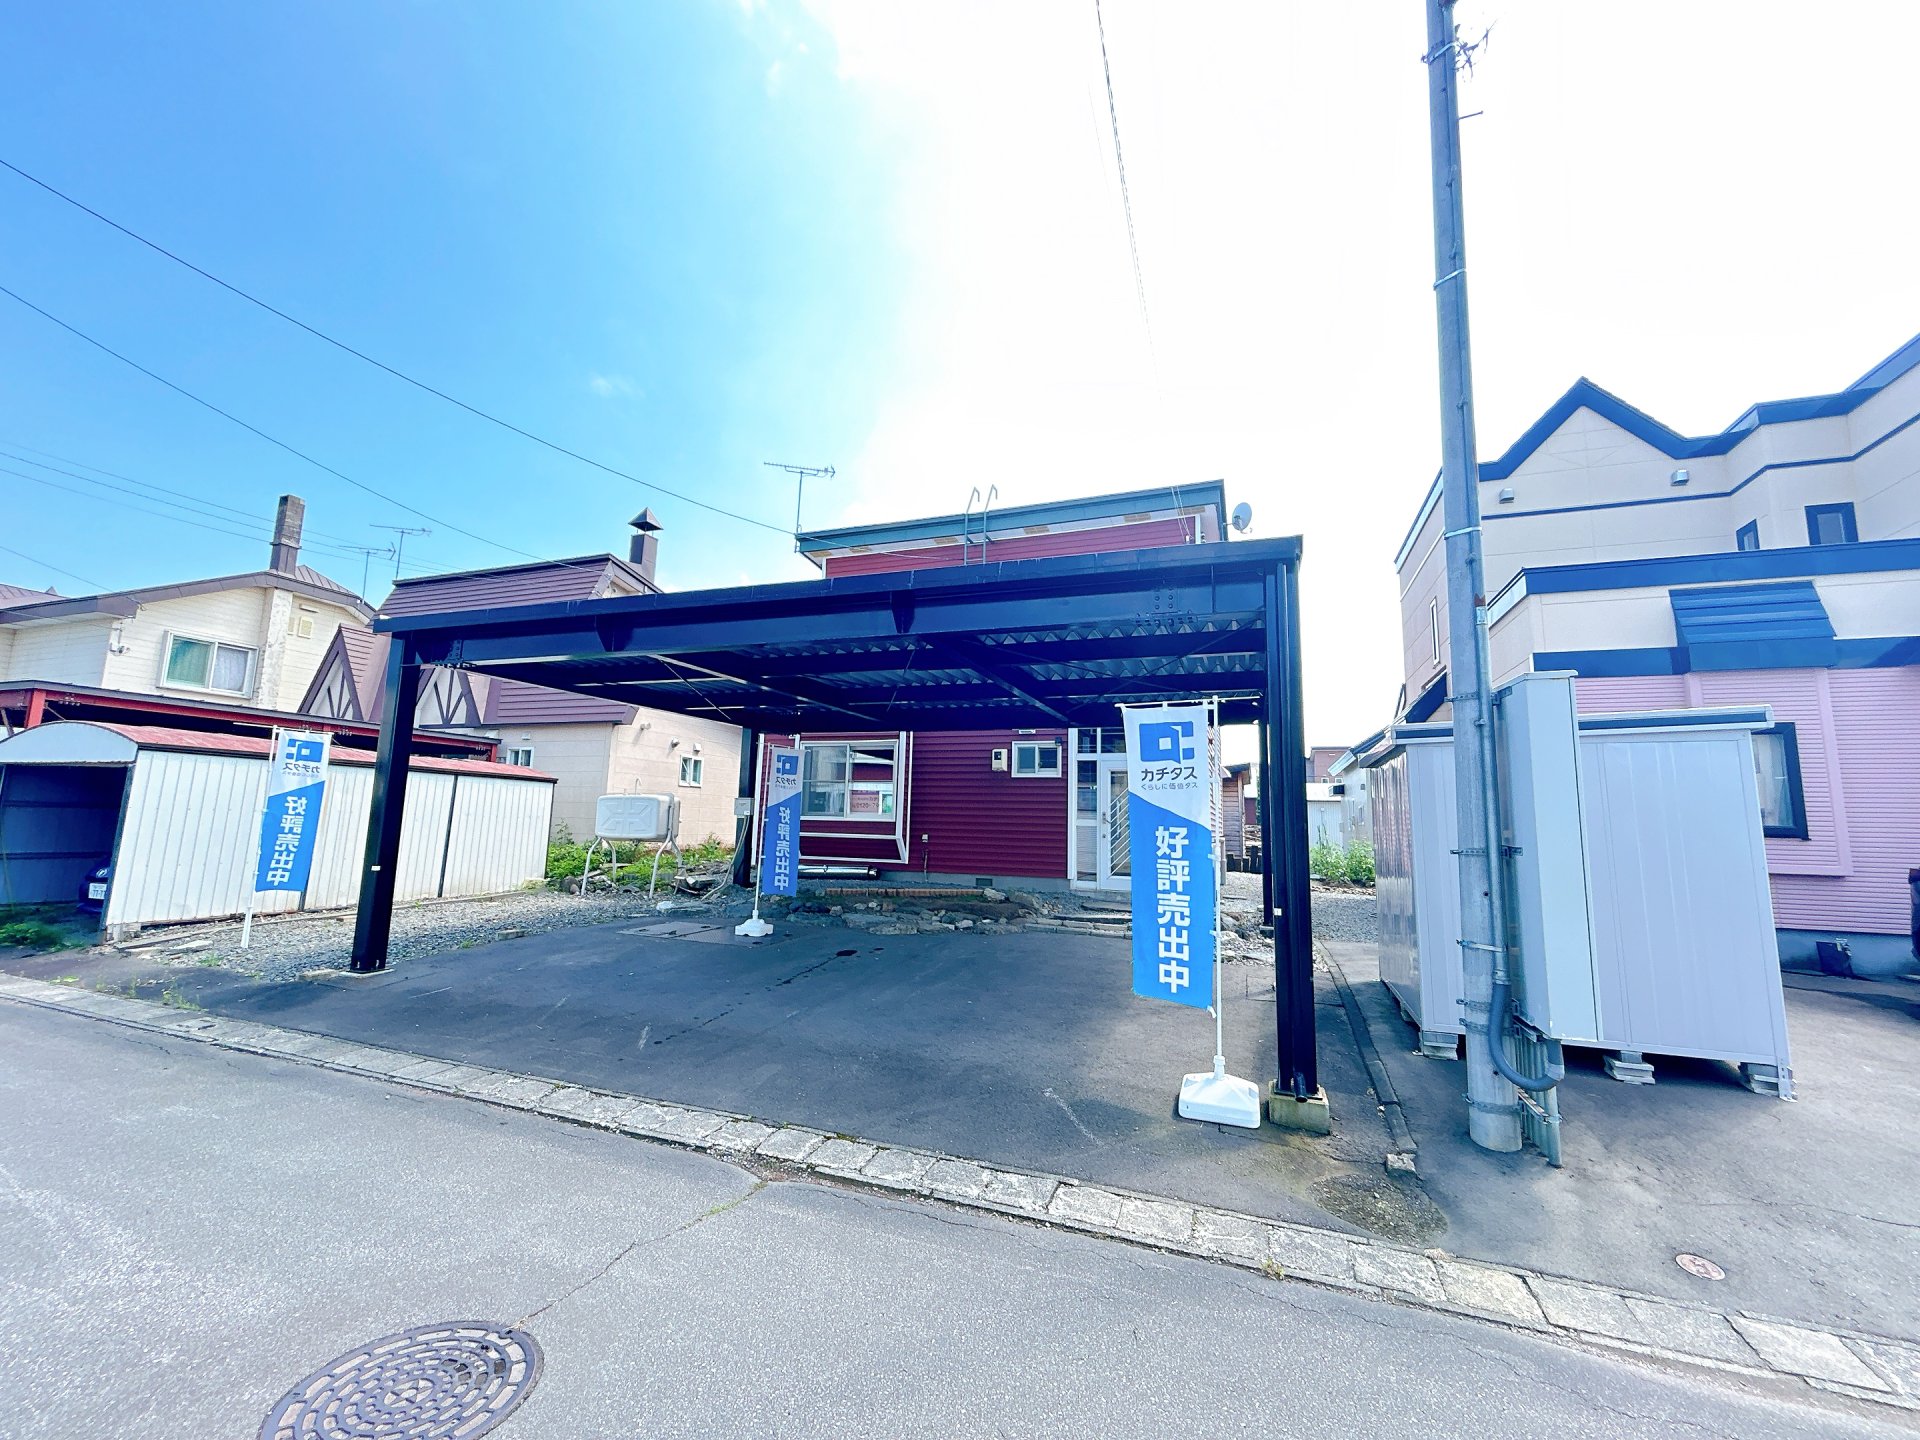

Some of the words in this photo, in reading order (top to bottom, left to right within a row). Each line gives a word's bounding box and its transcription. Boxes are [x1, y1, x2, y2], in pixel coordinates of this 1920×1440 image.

[1141, 766, 1198, 782] カチタス
[1141, 782, 1198, 791] くらしに価値タス
[1155, 825, 1191, 993] 好評売出中
